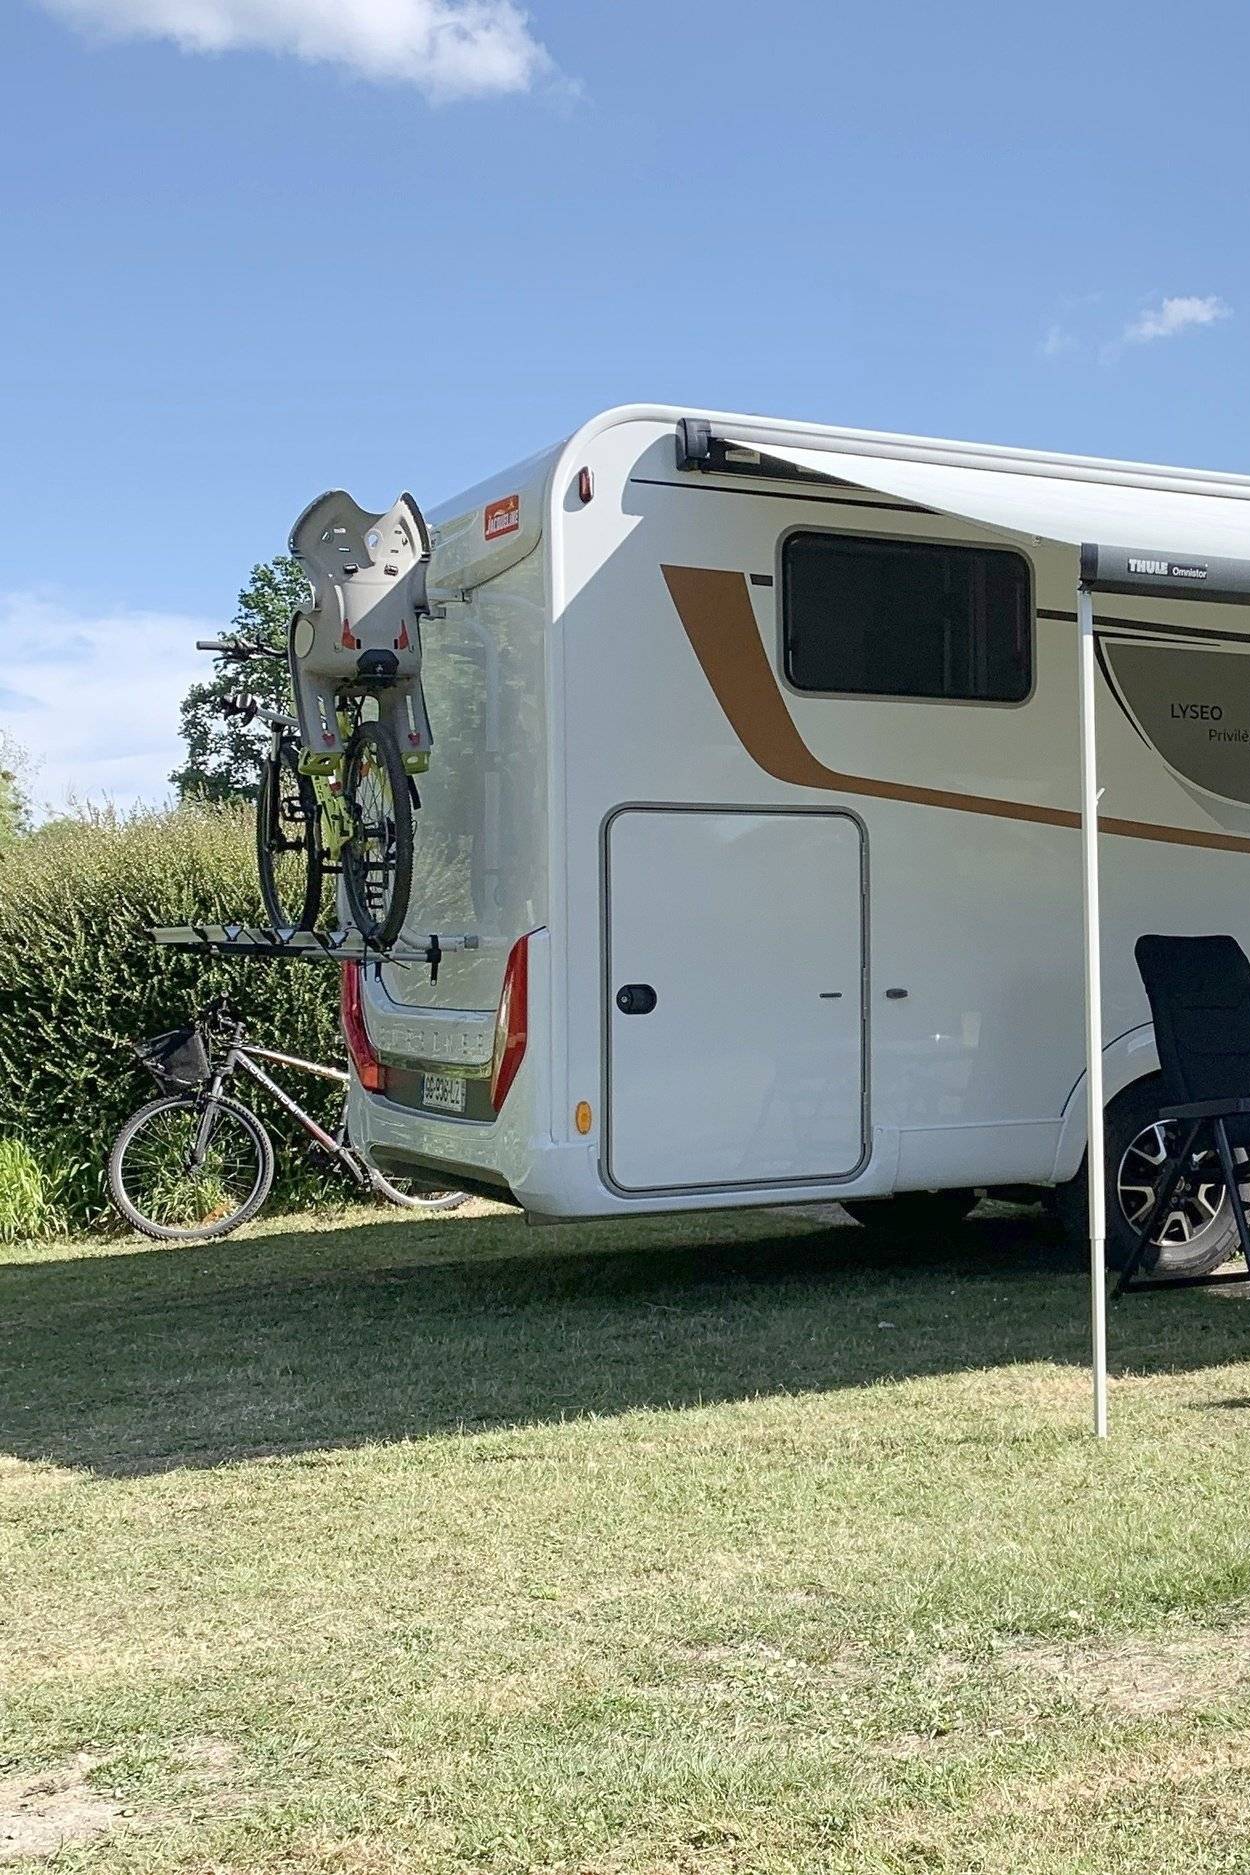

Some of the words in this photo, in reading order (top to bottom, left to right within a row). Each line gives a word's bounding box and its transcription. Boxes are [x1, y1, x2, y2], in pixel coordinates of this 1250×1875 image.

[1129, 558, 1168, 575] THULE
[1172, 566, 1208, 579] Omnistor
[1171, 703, 1223, 721] LYSEO
